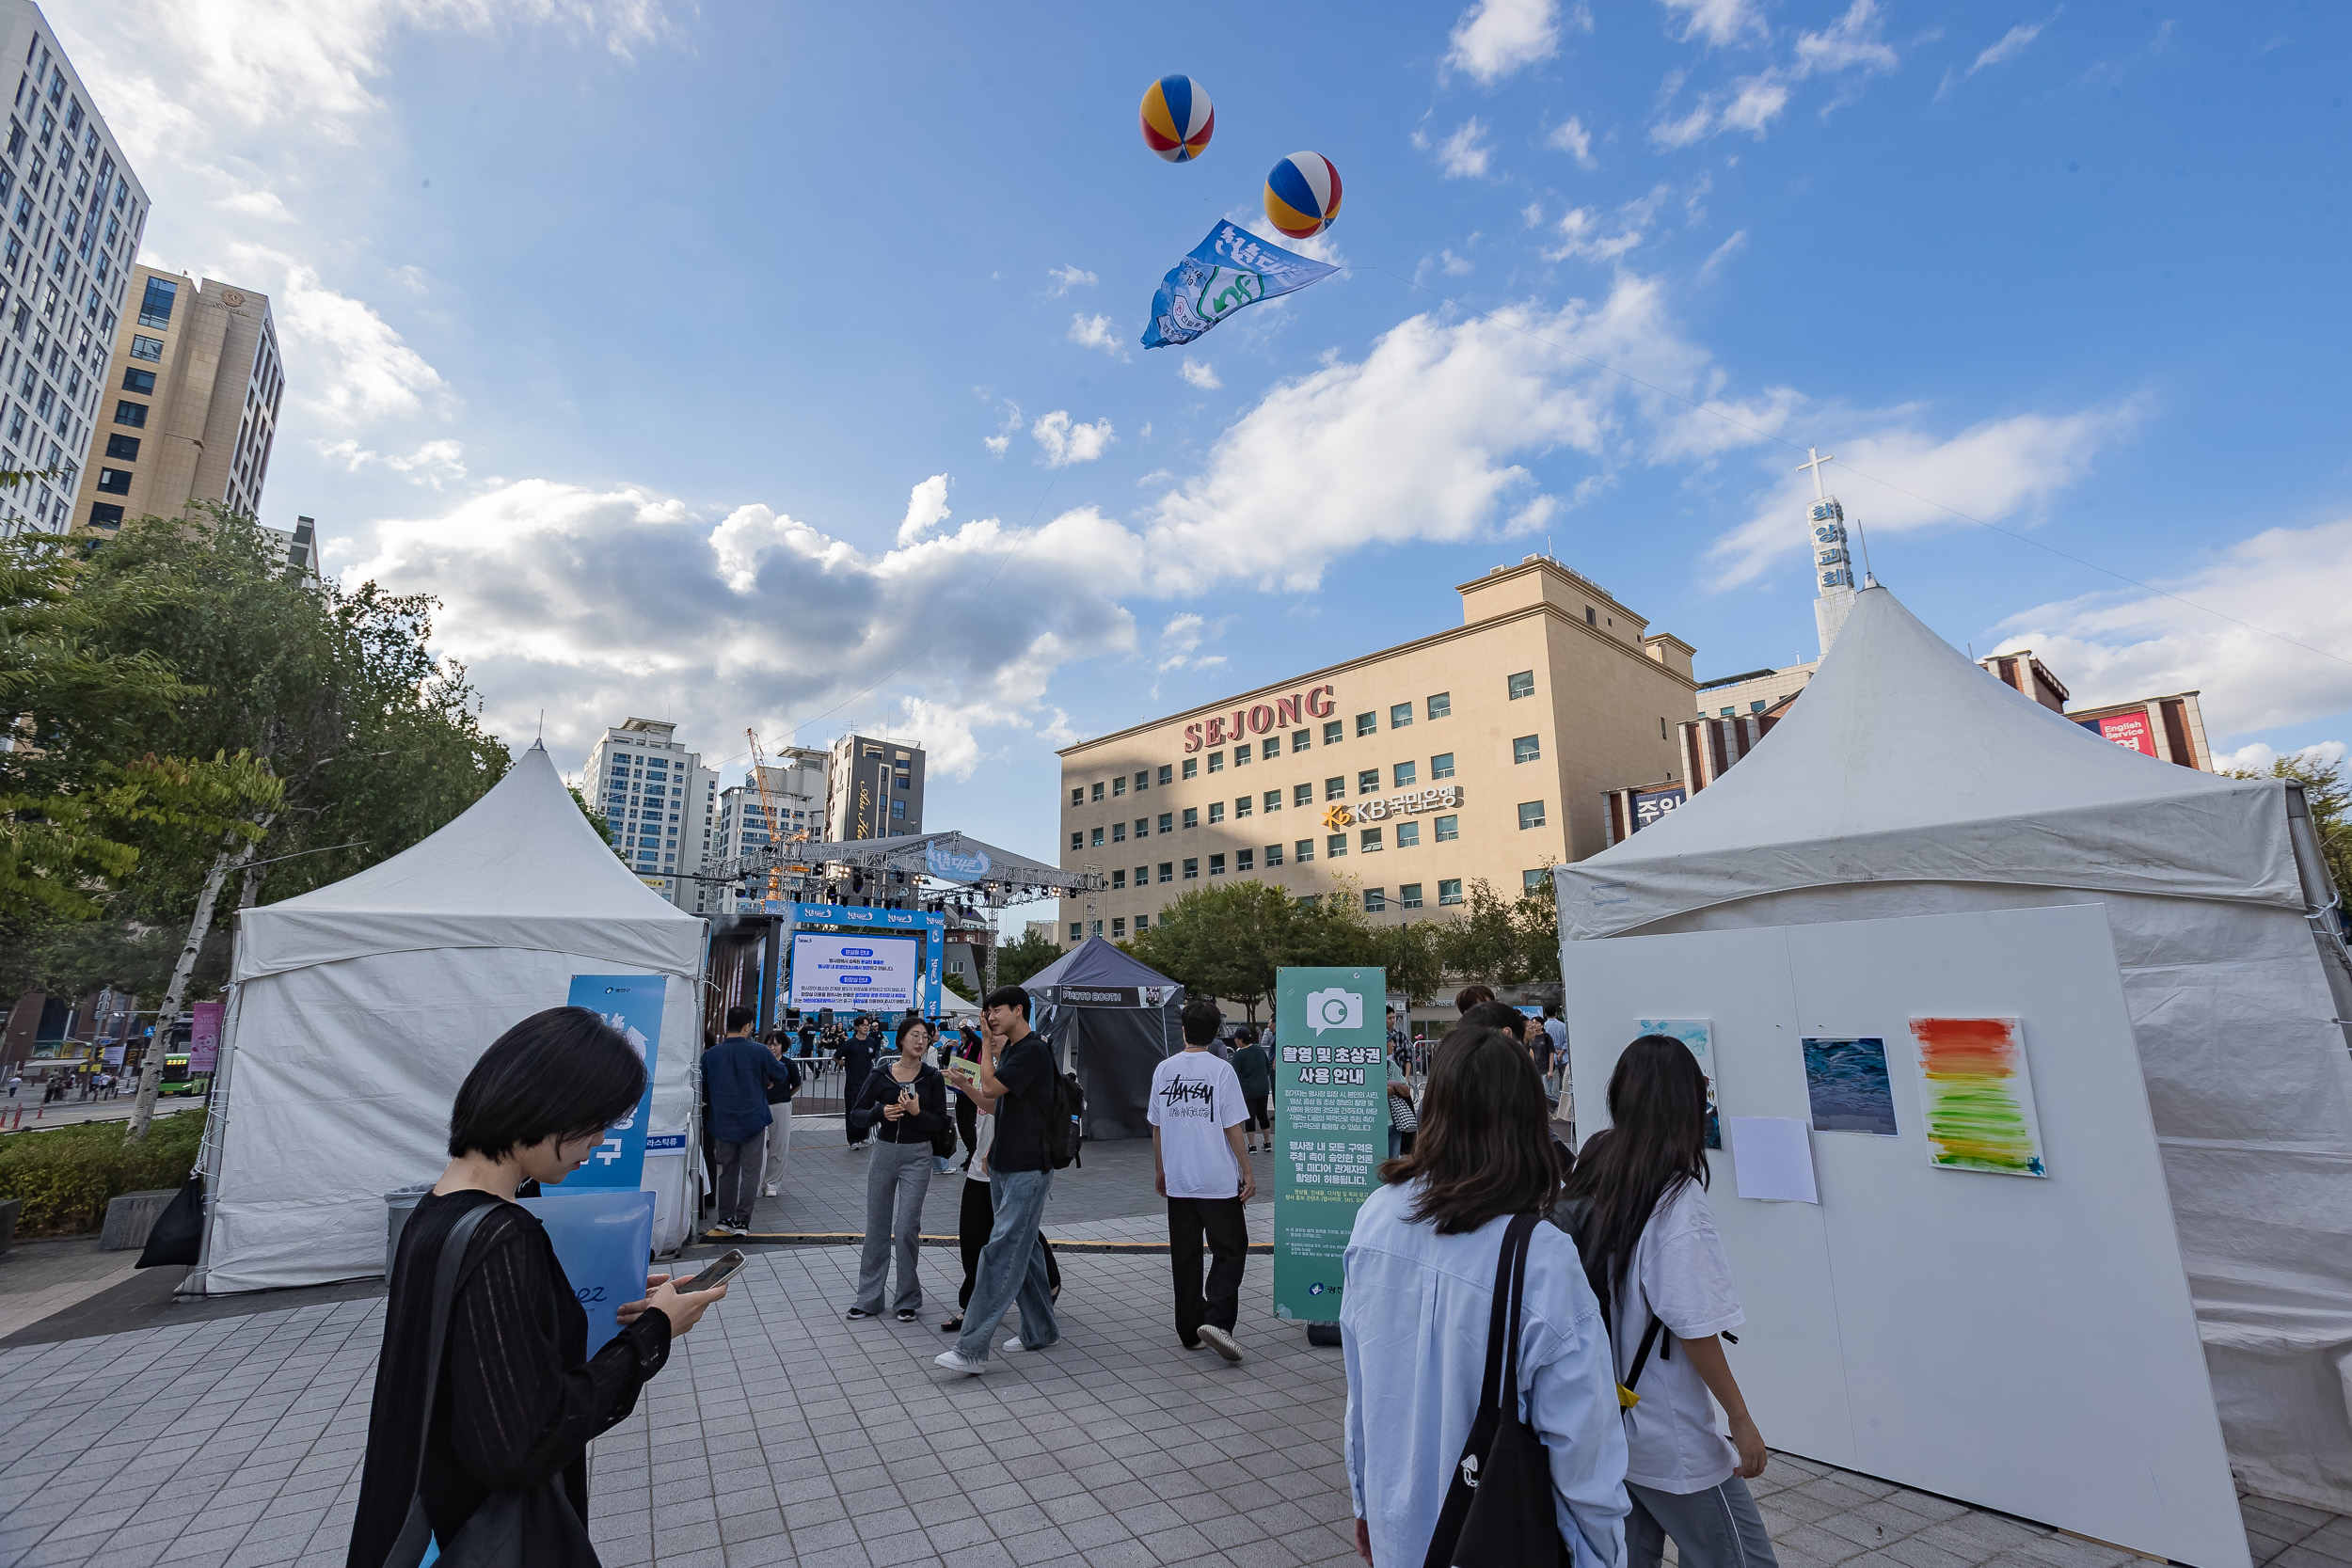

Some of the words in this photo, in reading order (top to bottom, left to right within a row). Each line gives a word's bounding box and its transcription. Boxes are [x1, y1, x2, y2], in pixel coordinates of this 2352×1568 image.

[1812, 502, 1841, 587] 화양교회
[1184, 685, 1335, 752] SEJONG
[2104, 721, 2142, 734] English
[2106, 728, 2144, 739] Service
[1062, 990, 1091, 1001] PHOTO
[1092, 992, 1121, 1002] BOOTH
[1282, 1045, 1312, 1063] 촬영
[1316, 1046, 1332, 1063] 및
[1335, 1047, 1381, 1064] 초상권
[1298, 1067, 1330, 1084] 사용
[1333, 1068, 1365, 1085] 안내
[646, 1138, 677, 1148] 라스틱류
[1289, 1141, 1314, 1150] 행사장
[1317, 1142, 1326, 1151] 내
[1328, 1143, 1345, 1152] 모든
[1348, 1143, 1374, 1153] 구역은
[1289, 1152, 1306, 1161] 주최
[1309, 1152, 1326, 1162] 측이
[1328, 1153, 1353, 1164] 승인한
[1357, 1154, 1374, 1164] 언론
[1295, 1163, 1303, 1172] 및
[1307, 1164, 1331, 1173] 미디어
[1334, 1164, 1368, 1174] 관계자의
[1295, 1174, 1320, 1183] 촬영이
[1324, 1175, 1367, 1185] 허용됩니다.
[572, 1286, 608, 1303] ez
[1327, 1286, 1343, 1294] 광진
